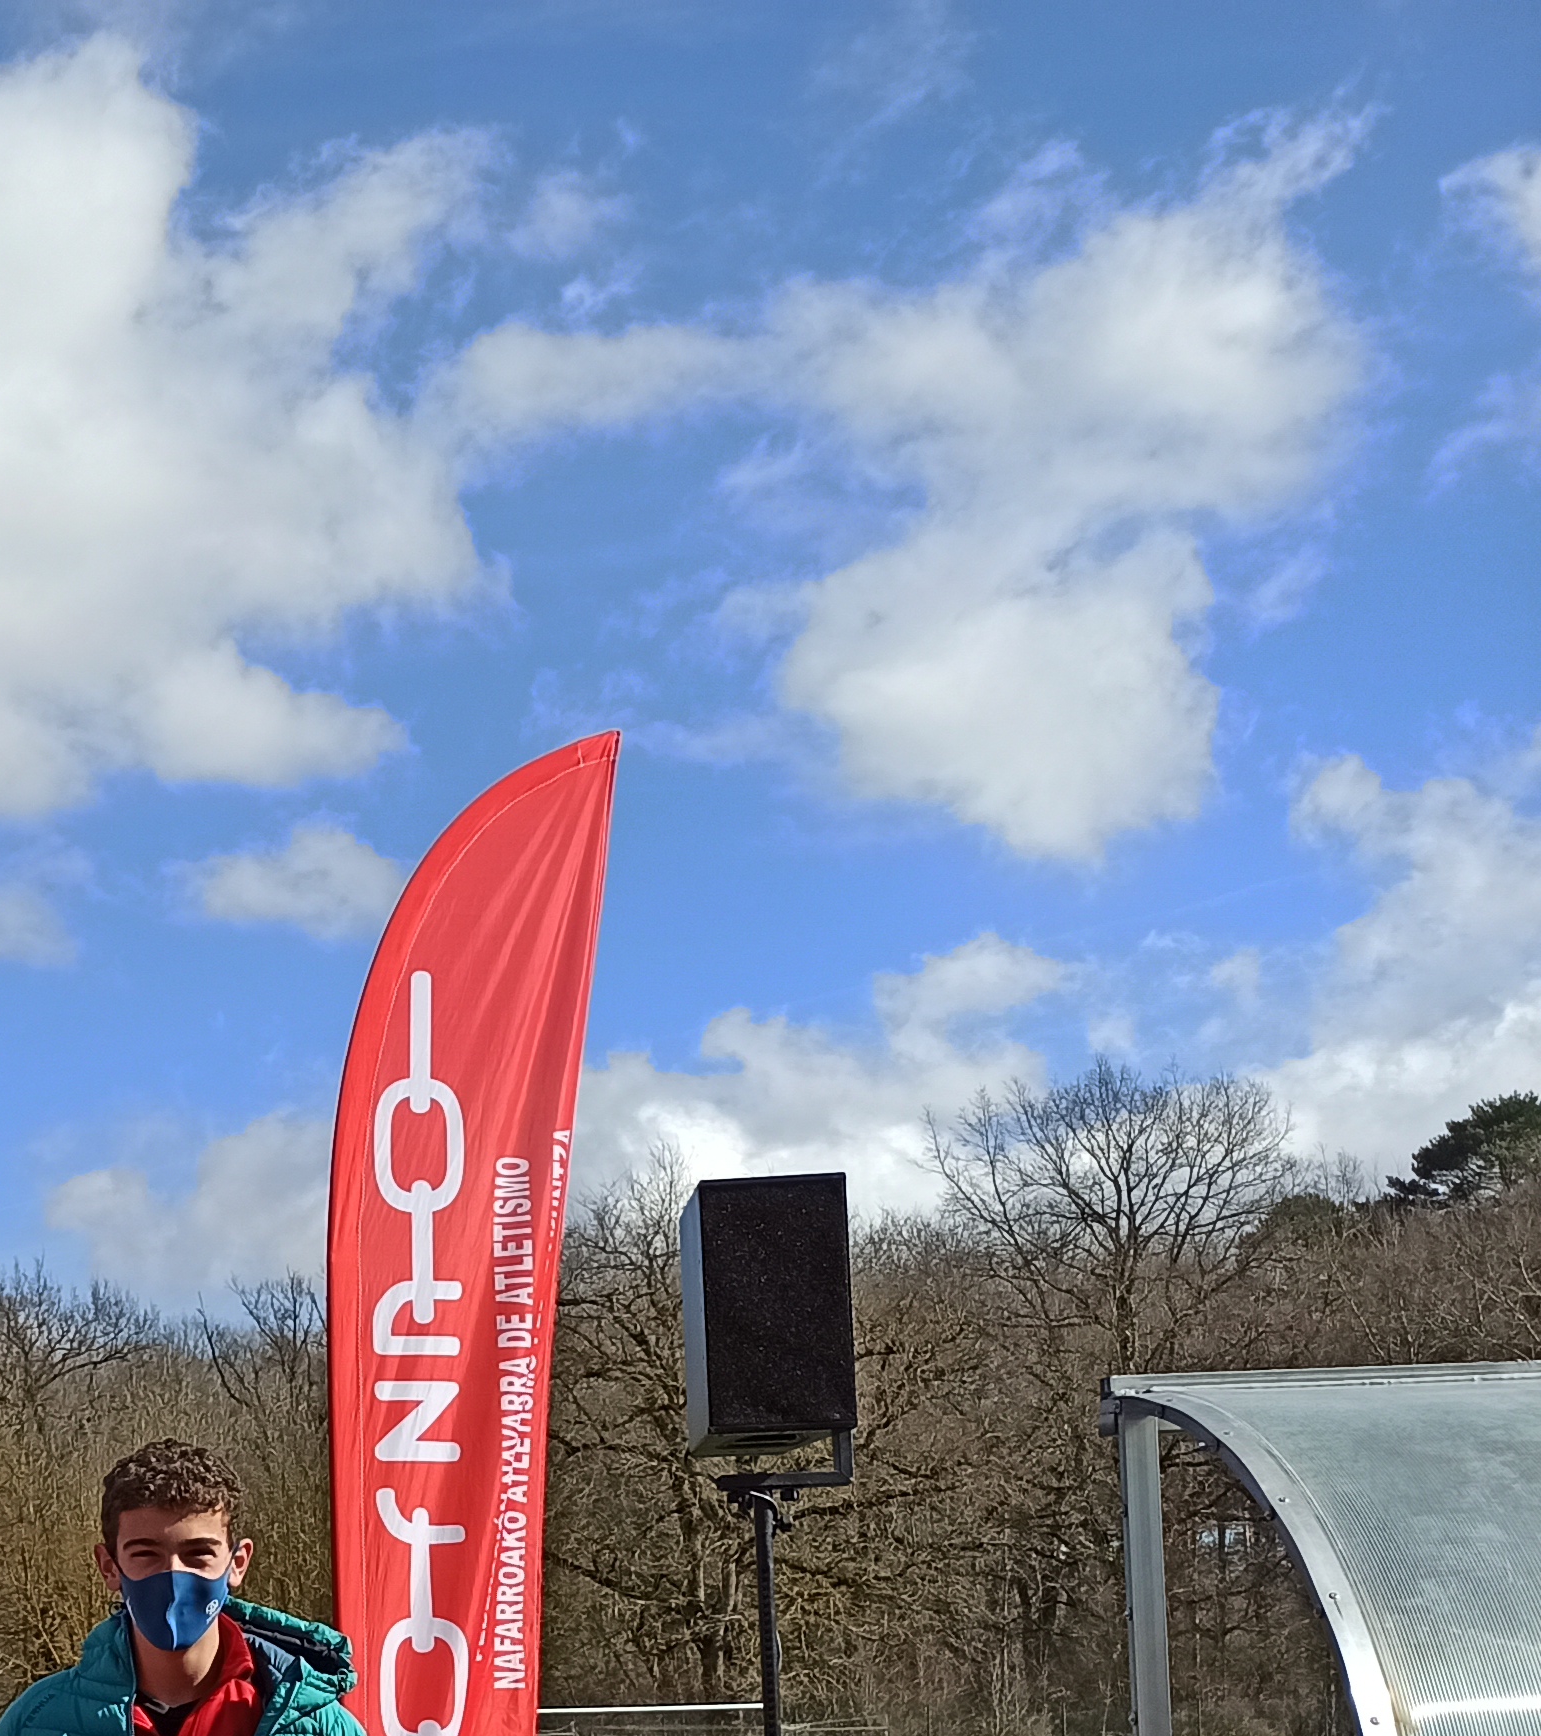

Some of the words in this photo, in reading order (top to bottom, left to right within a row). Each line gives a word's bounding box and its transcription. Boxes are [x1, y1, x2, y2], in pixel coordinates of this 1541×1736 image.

[493, 1156, 534, 1306] ATLETISMO
[497, 1313, 534, 1348] DE
[493, 1510, 527, 1690] NAFARROAKO
